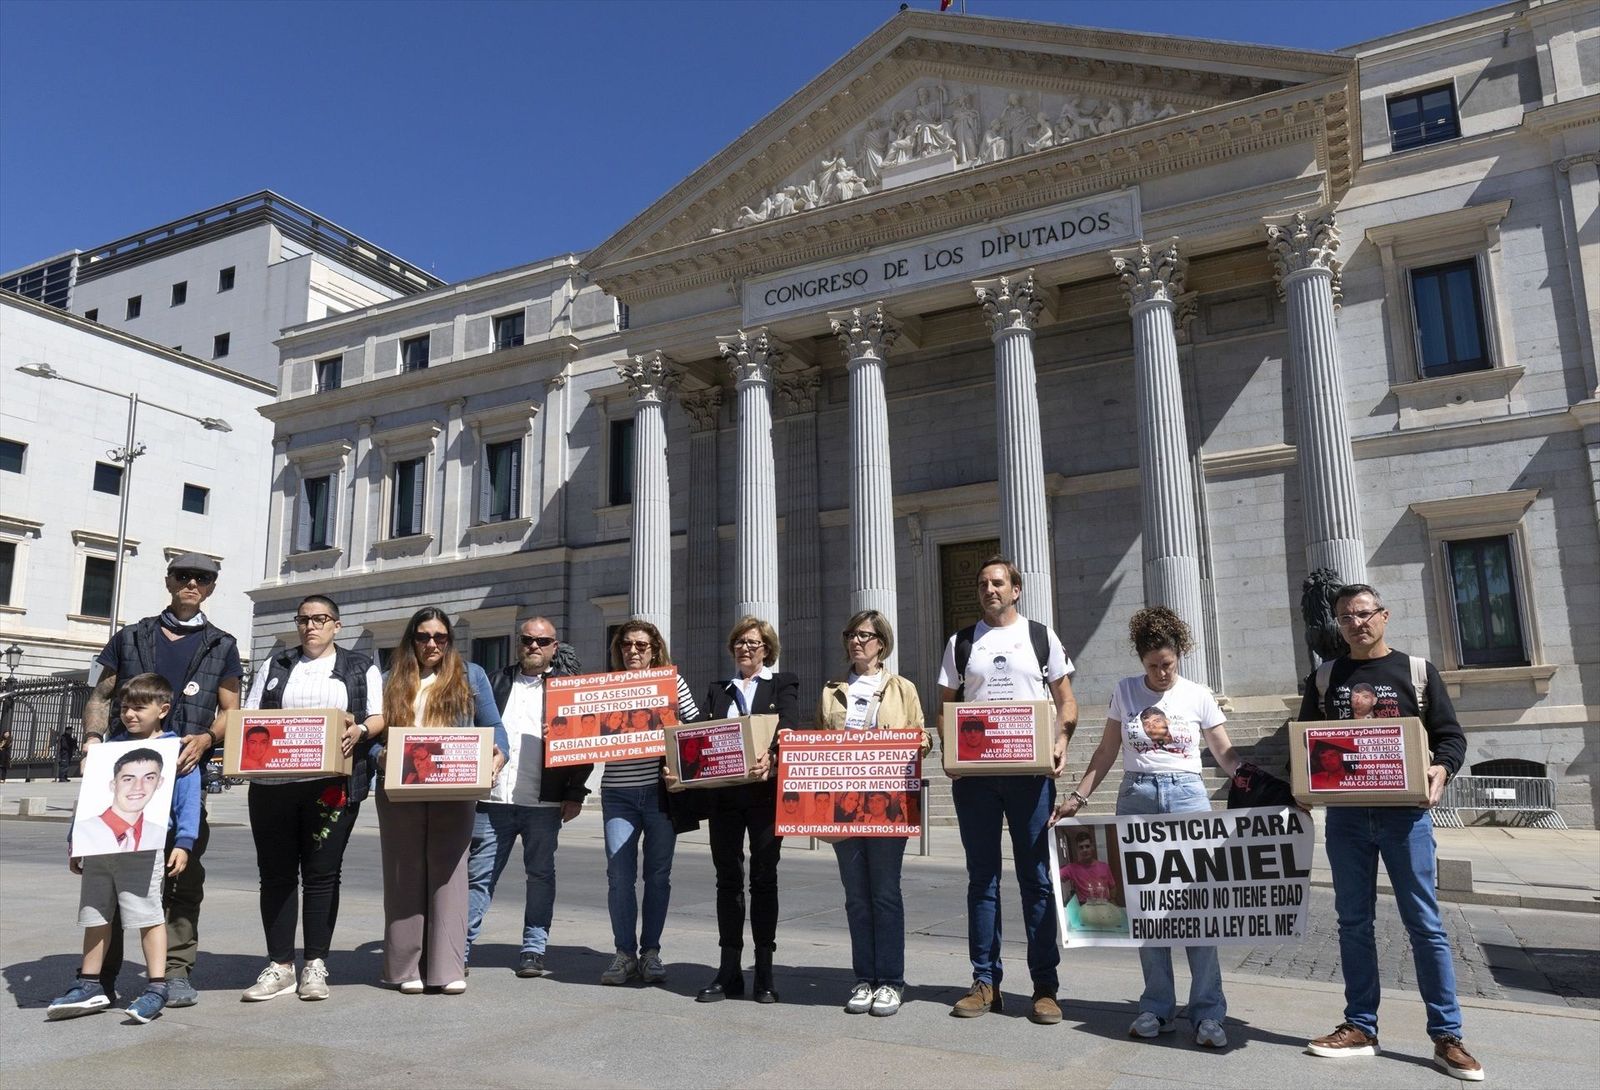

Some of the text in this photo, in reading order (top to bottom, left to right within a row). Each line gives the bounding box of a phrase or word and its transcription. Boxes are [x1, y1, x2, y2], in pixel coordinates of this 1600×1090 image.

[765, 212, 1110, 305] CONGRESO DE LOS DIPUTADOS
[550, 668, 674, 688] change.org/LeyDelMenor
[580, 687, 652, 701] LOS ASESINOS
[578, 701, 633, 713] NUESTROS
[636, 698, 664, 707] HIJOS
[1339, 708, 1350, 719] DE
[679, 726, 739, 738] change.org/LeyDelMenor
[784, 731, 918, 743] change.org/LeyDelMenor
[1310, 729, 1398, 737] change.org/LeyDelMenor
[595, 736, 608, 746] LO
[611, 735, 632, 746] QUE
[787, 751, 915, 761] ENDURECER LAS PENAS
[790, 766, 912, 776] ANTE DELITOS GRAVES
[784, 780, 919, 790] COMETIDOS POR MENORES
[797, 825, 840, 834] QUITARON
[1122, 813, 1304, 844] JUSTICIA PARA
[1124, 843, 1310, 885] DANIEL
[1140, 884, 1303, 911] UN ASESINO NO TIENE EDAD
[1132, 914, 1297, 939] ENDURECER LA LEY DEL ME
